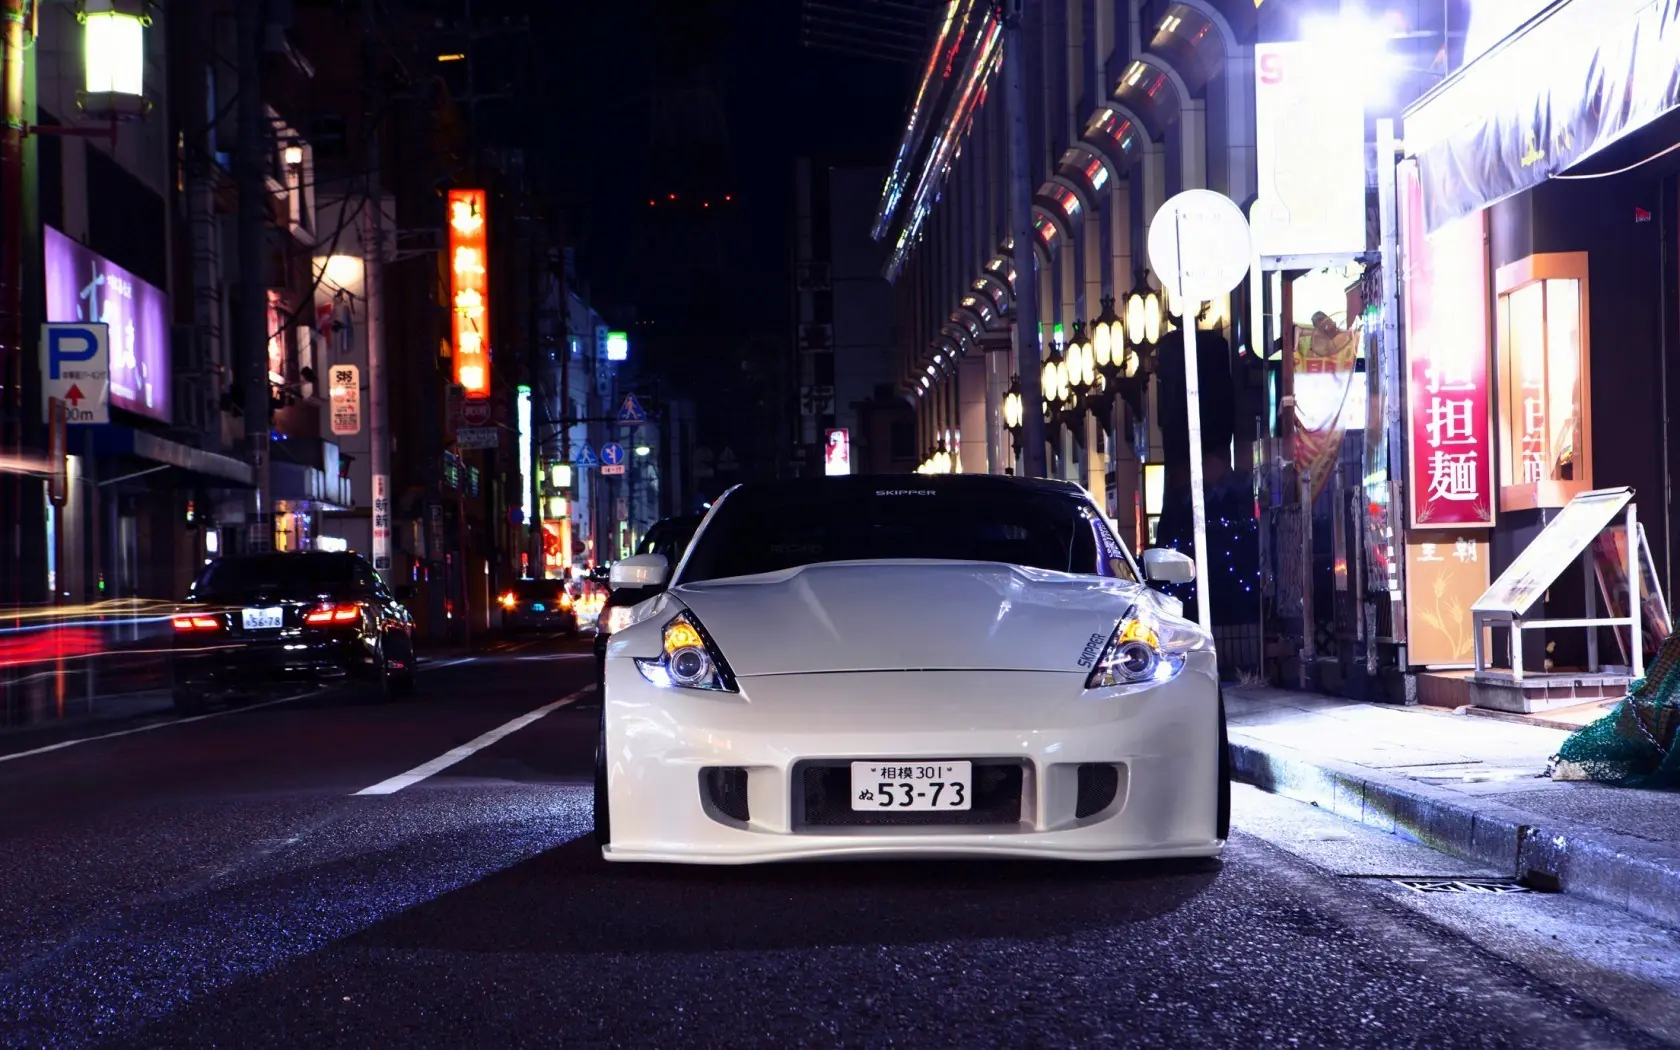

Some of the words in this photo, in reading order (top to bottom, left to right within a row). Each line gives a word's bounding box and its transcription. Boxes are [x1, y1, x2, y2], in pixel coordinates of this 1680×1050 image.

[48, 328, 98, 380] P
[251, 616, 281, 627] 56-78
[1077, 633, 1106, 668] SKIPPER
[878, 782, 965, 807] 53-73
